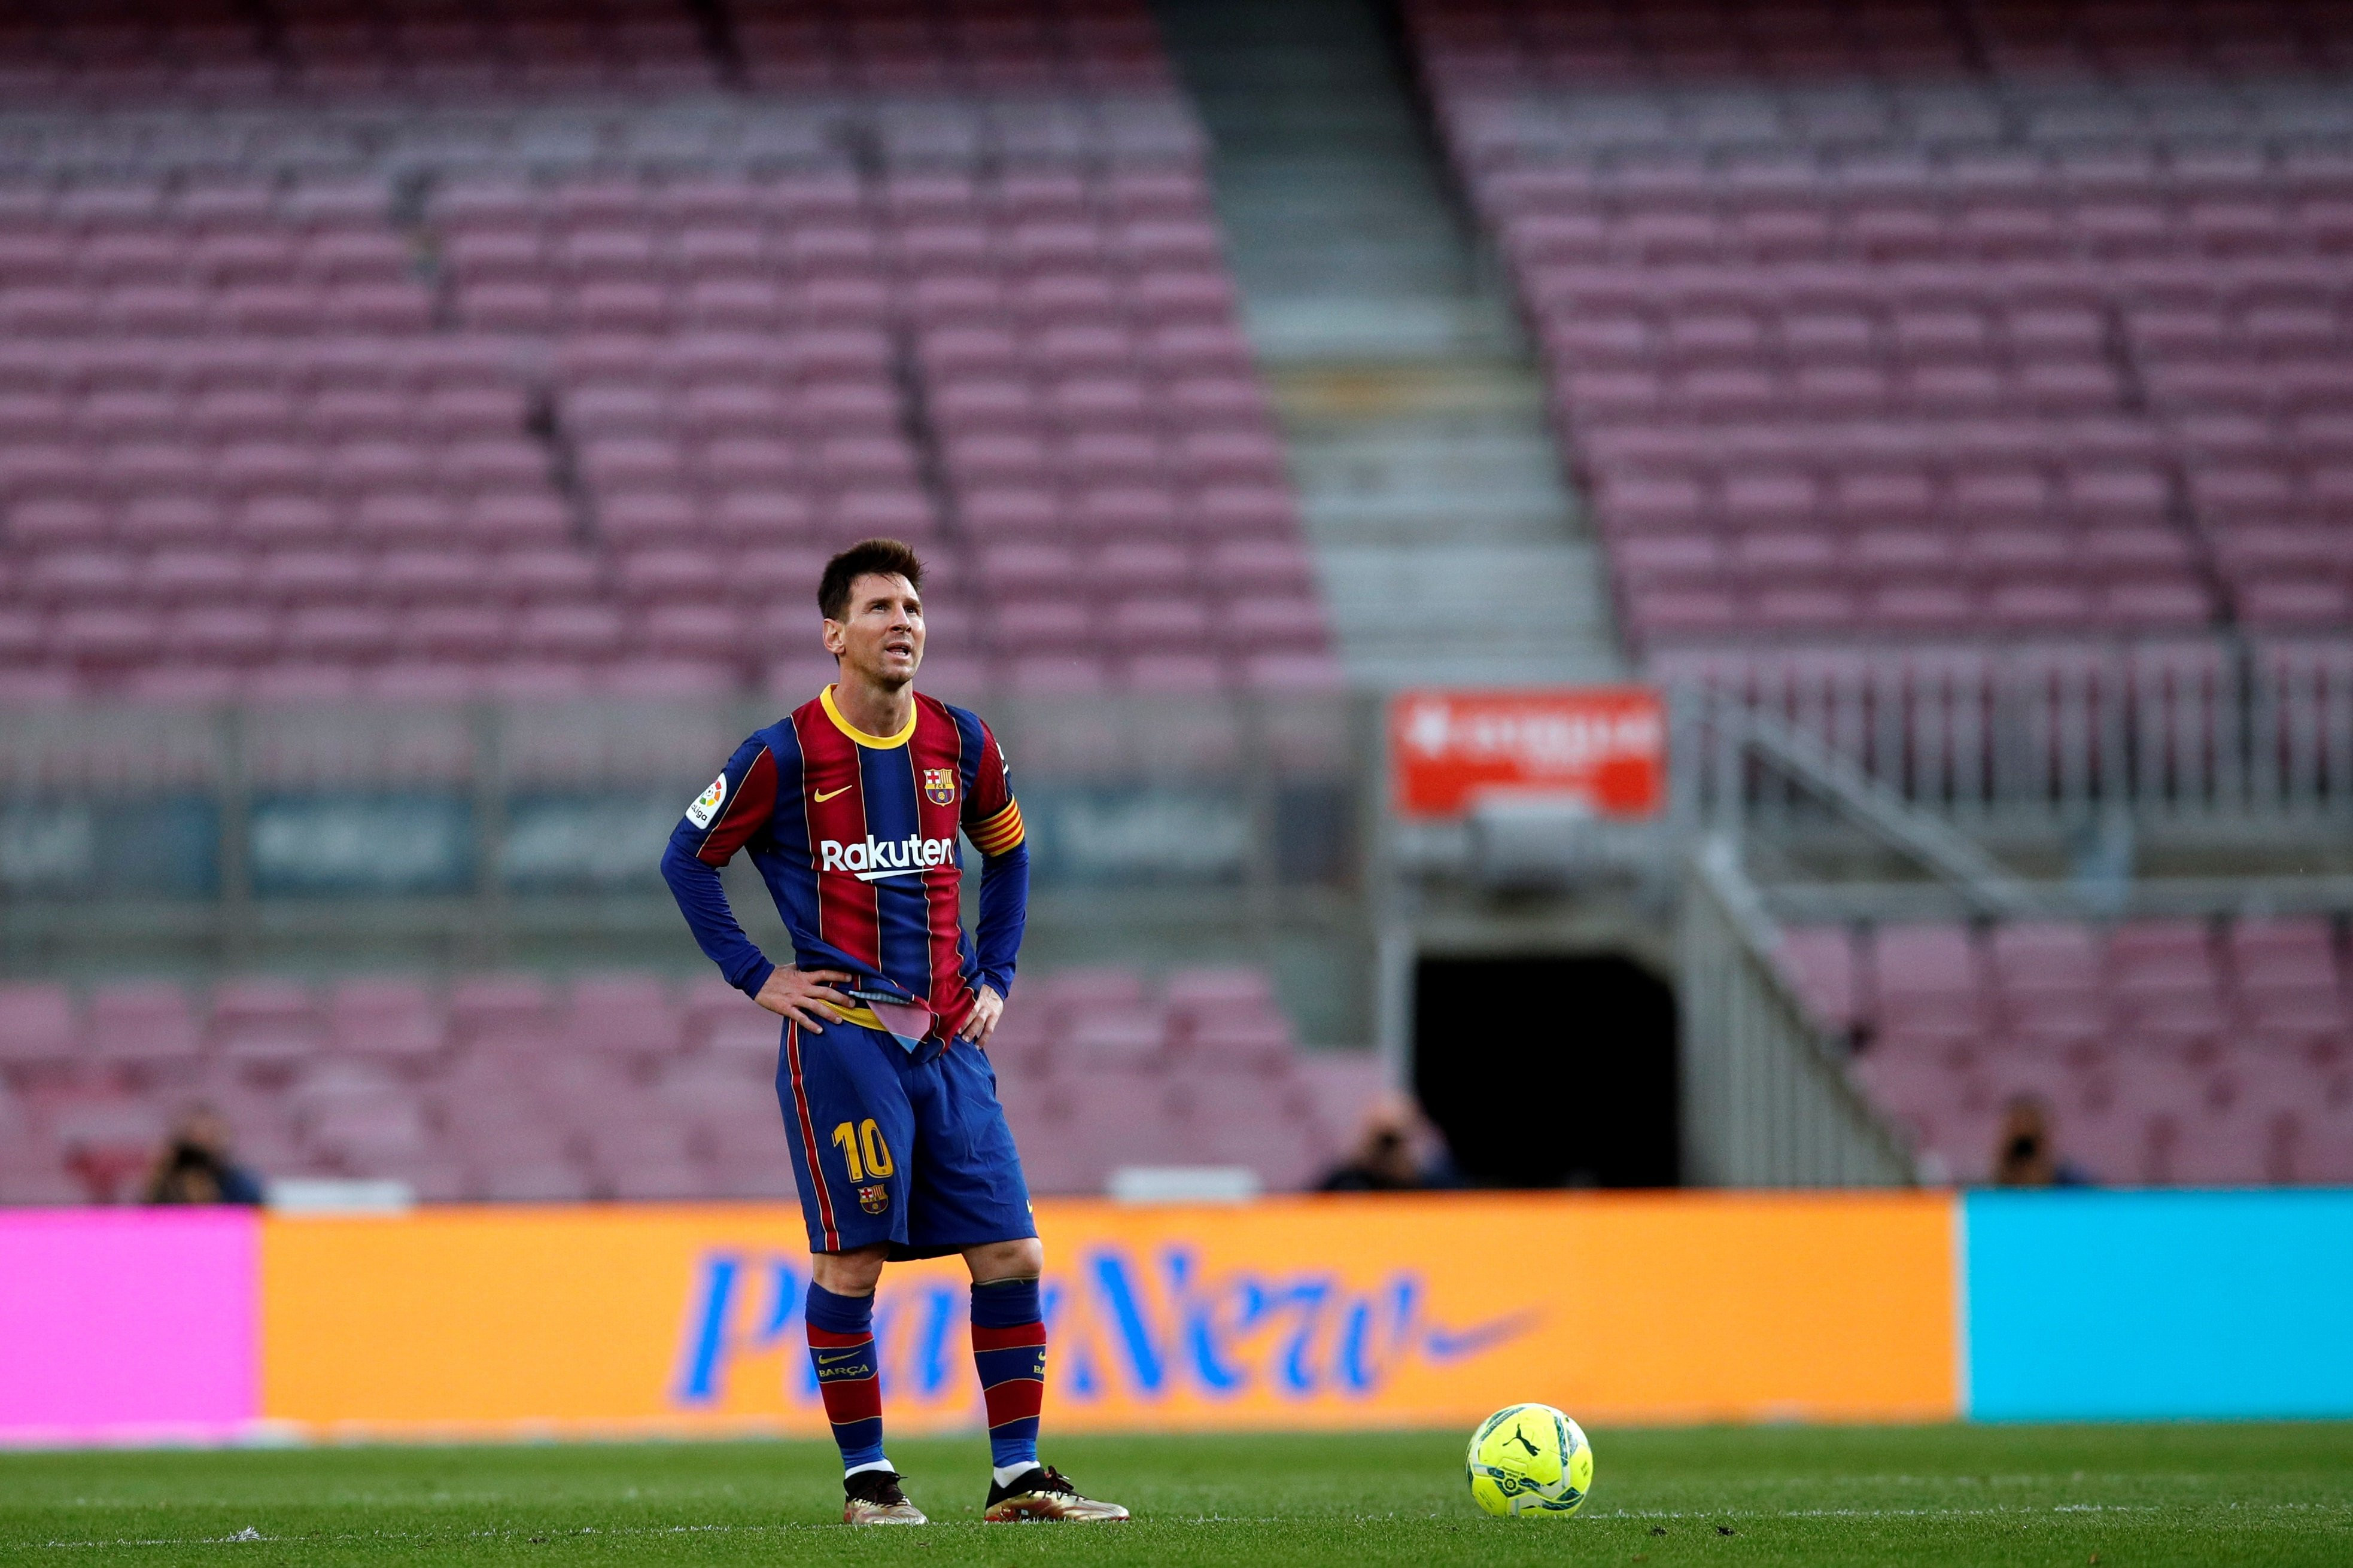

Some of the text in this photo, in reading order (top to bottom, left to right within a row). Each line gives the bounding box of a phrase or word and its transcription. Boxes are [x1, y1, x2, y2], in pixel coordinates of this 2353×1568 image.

[820, 834, 953, 872] Rakuten
[831, 1118, 893, 1183] 10
[819, 1364, 869, 1377] BARÇA
